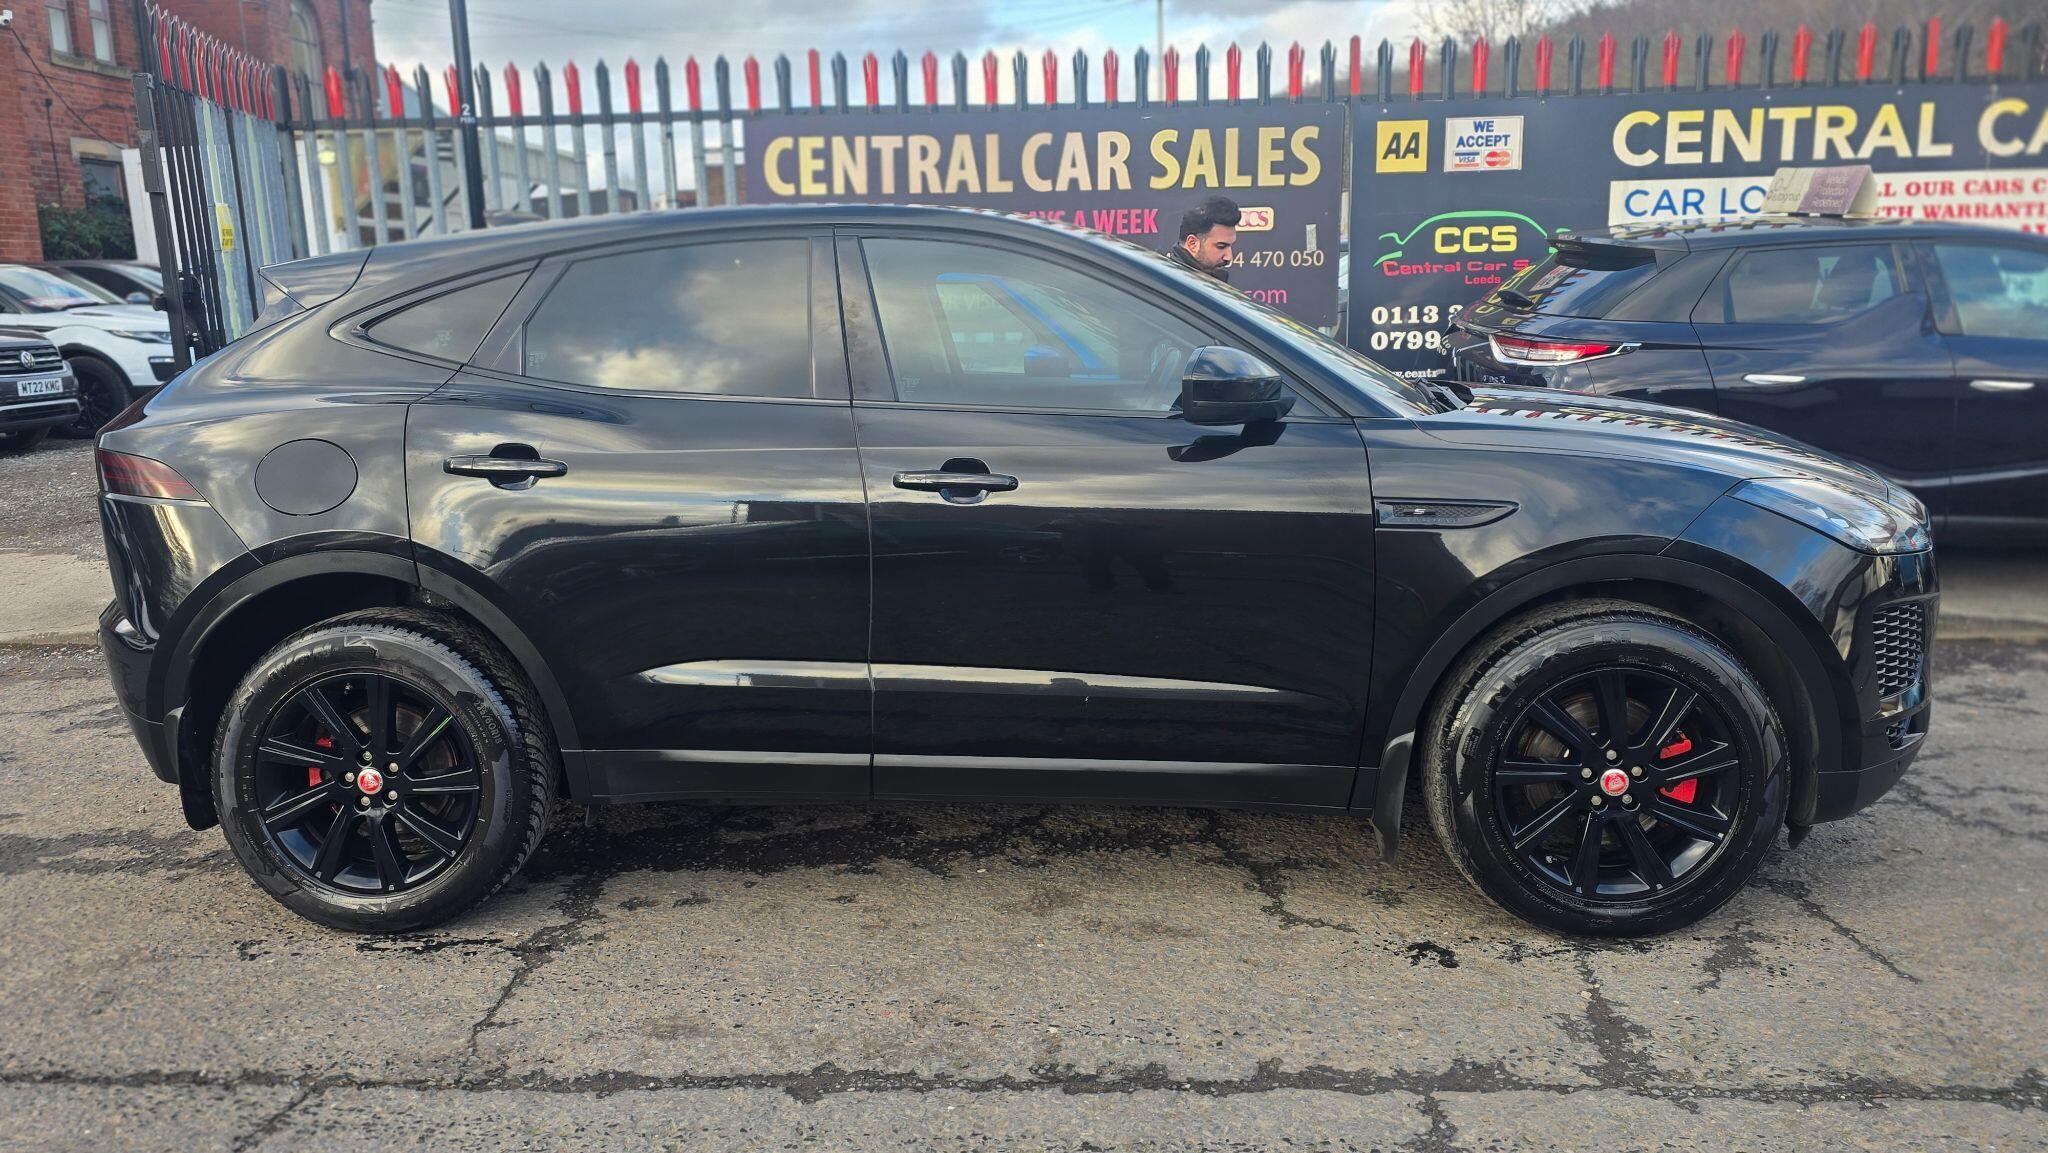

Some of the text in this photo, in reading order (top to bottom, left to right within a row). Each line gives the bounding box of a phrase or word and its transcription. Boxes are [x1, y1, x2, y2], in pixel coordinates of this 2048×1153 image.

[461, 103, 471, 116] 2
[1473, 120, 1494, 132] WE
[1612, 102, 1953, 167] CENTRAL
[1382, 131, 1420, 160] AA
[1456, 134, 1511, 148] ACCEPT
[764, 126, 1321, 196] CENTRAL CAR SALES
[1905, 181, 1954, 197] OUR
[1963, 179, 2025, 196] CARS
[1625, 189, 1705, 217] CAR
[1093, 208, 1159, 235] WEEK
[1434, 225, 1518, 254] CCS
[1250, 251, 1284, 268] 470
[1290, 250, 1324, 267] 050
[1383, 260, 1461, 277] Central
[1467, 261, 1507, 272] Car
[1464, 275, 1501, 285] Leeds
[1371, 305, 1439, 325] 0113
[21, 382, 44, 394] MT22
